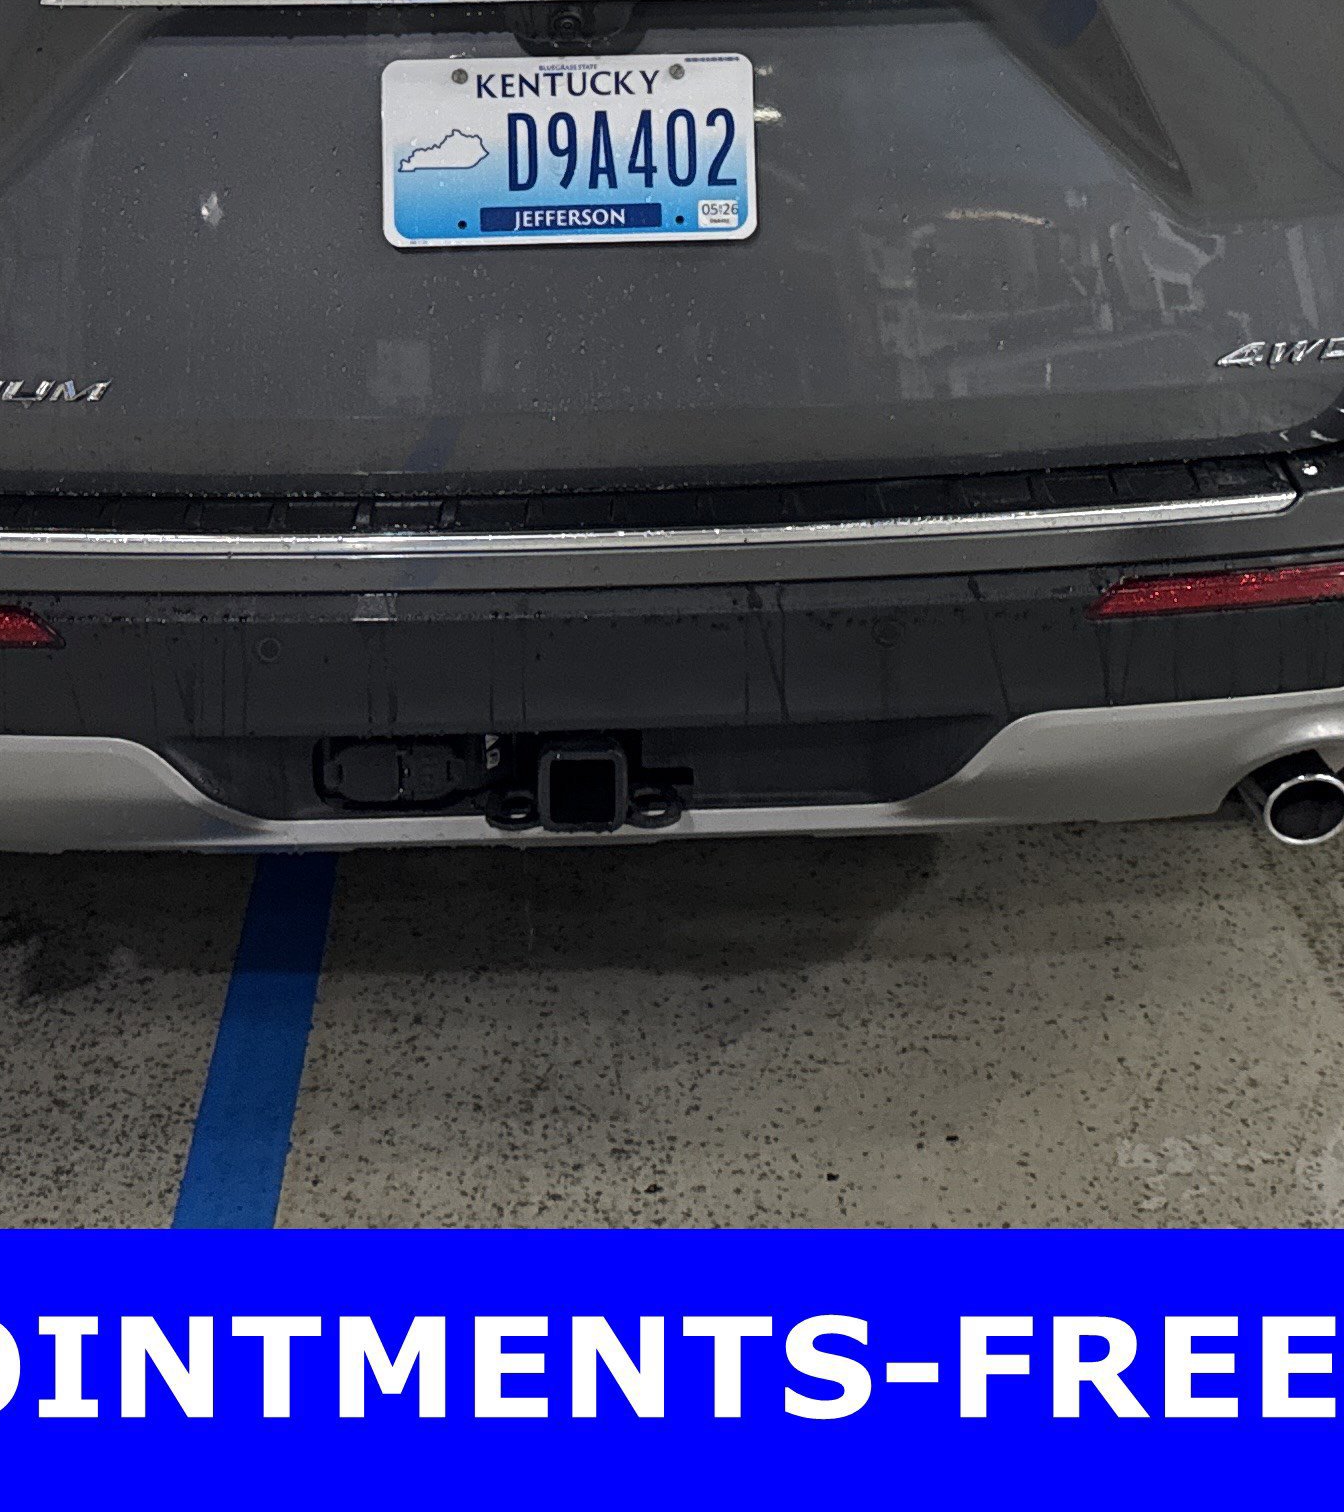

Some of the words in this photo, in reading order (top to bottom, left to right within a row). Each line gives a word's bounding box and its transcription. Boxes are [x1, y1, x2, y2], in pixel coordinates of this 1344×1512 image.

[476, 70, 660, 99] KENTUCKY
[507, 107, 738, 191] D9A402
[514, 209, 626, 231] JEFFERSON
